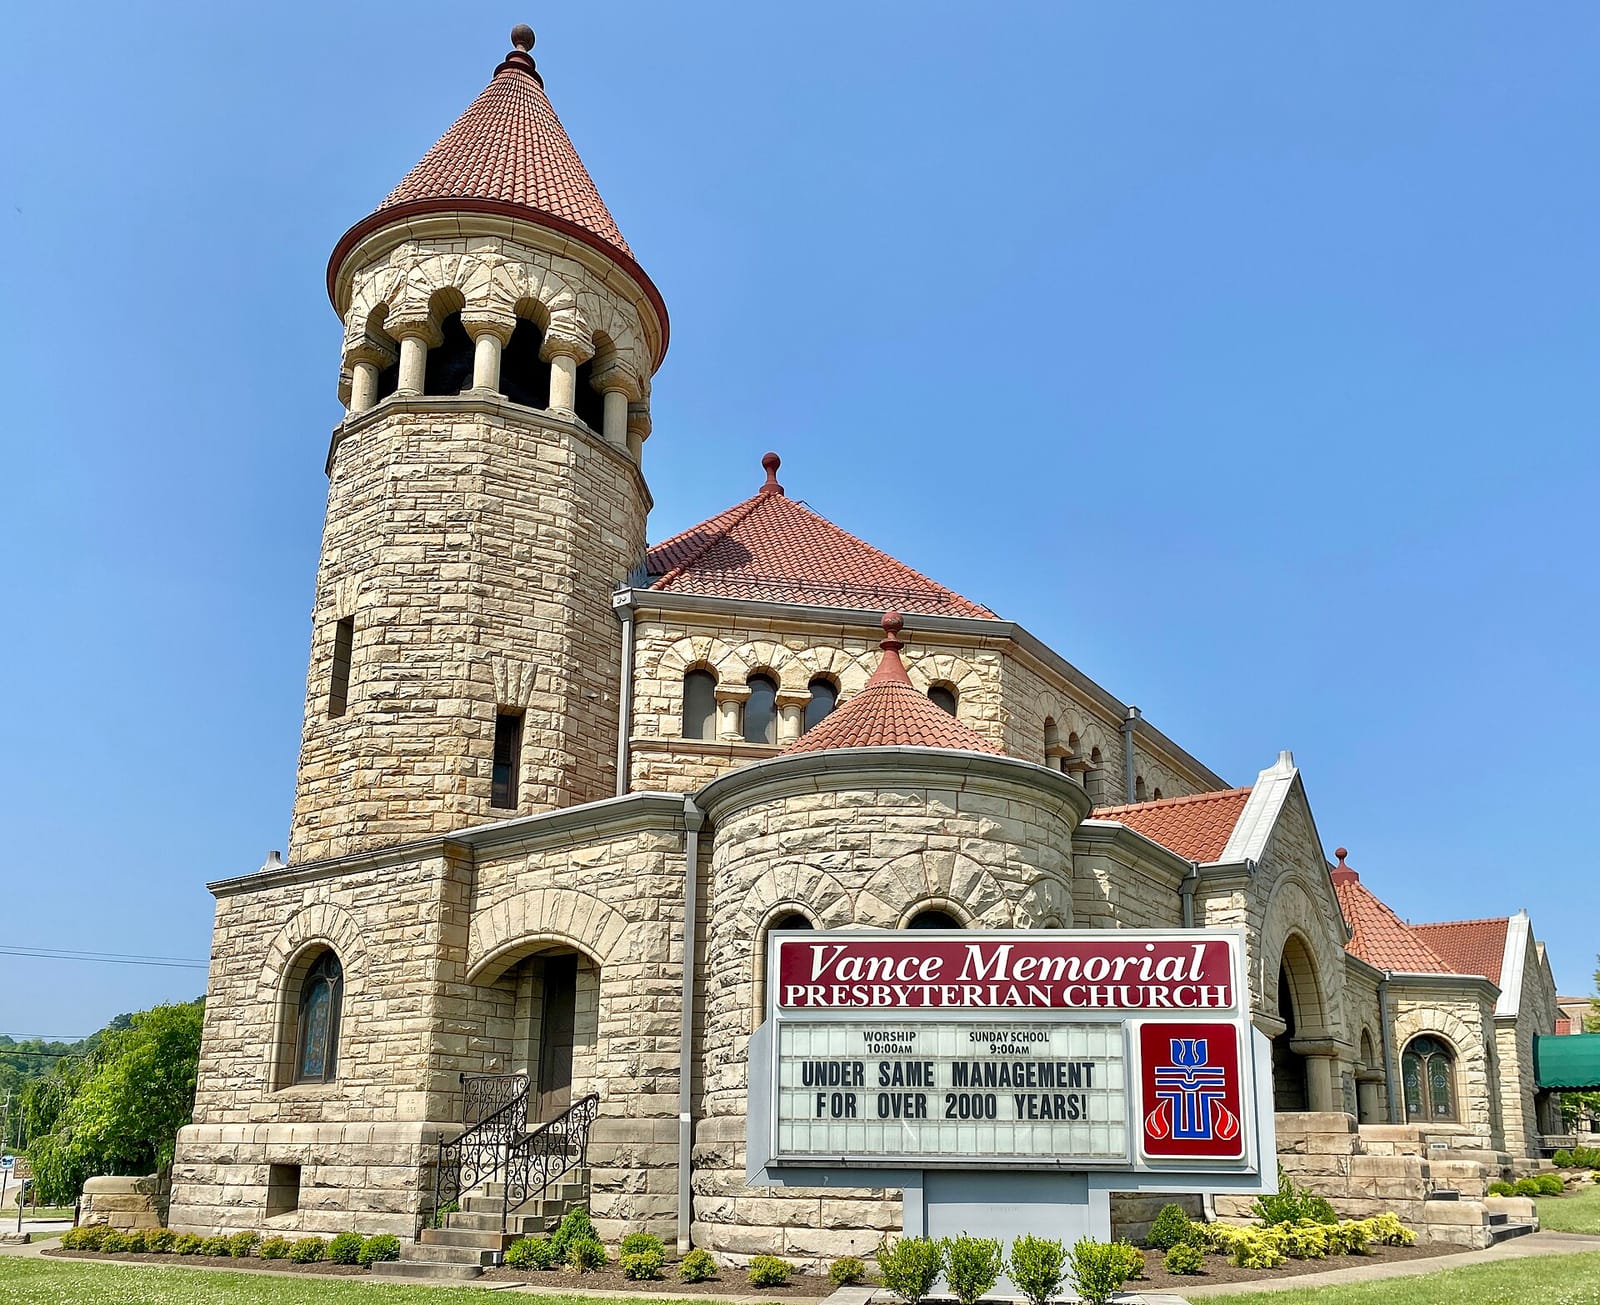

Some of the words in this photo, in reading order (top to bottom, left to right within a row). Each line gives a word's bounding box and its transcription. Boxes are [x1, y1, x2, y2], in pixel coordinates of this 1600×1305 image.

[809, 945, 944, 982] Vance
[956, 943, 1206, 982] Memorial
[785, 985, 1052, 1007] PRESBYTERIAN
[1062, 985, 1230, 1008] CHURCH
[863, 1031, 917, 1042] WORSHIP
[969, 1031, 1009, 1042] SUNDAY
[1010, 1031, 1050, 1042] SCHOOL
[867, 1043, 913, 1054] 10:00AM
[989, 1044, 1030, 1054] 9:00AM
[802, 1061, 865, 1088] UNDER
[878, 1061, 935, 1088] SAME
[951, 1061, 1095, 1088] MANAGEMENT
[816, 1092, 857, 1119] FOR
[877, 1092, 927, 1119] OVER
[945, 1093, 997, 1120] 2000
[1015, 1093, 1087, 1120] YEARS!
